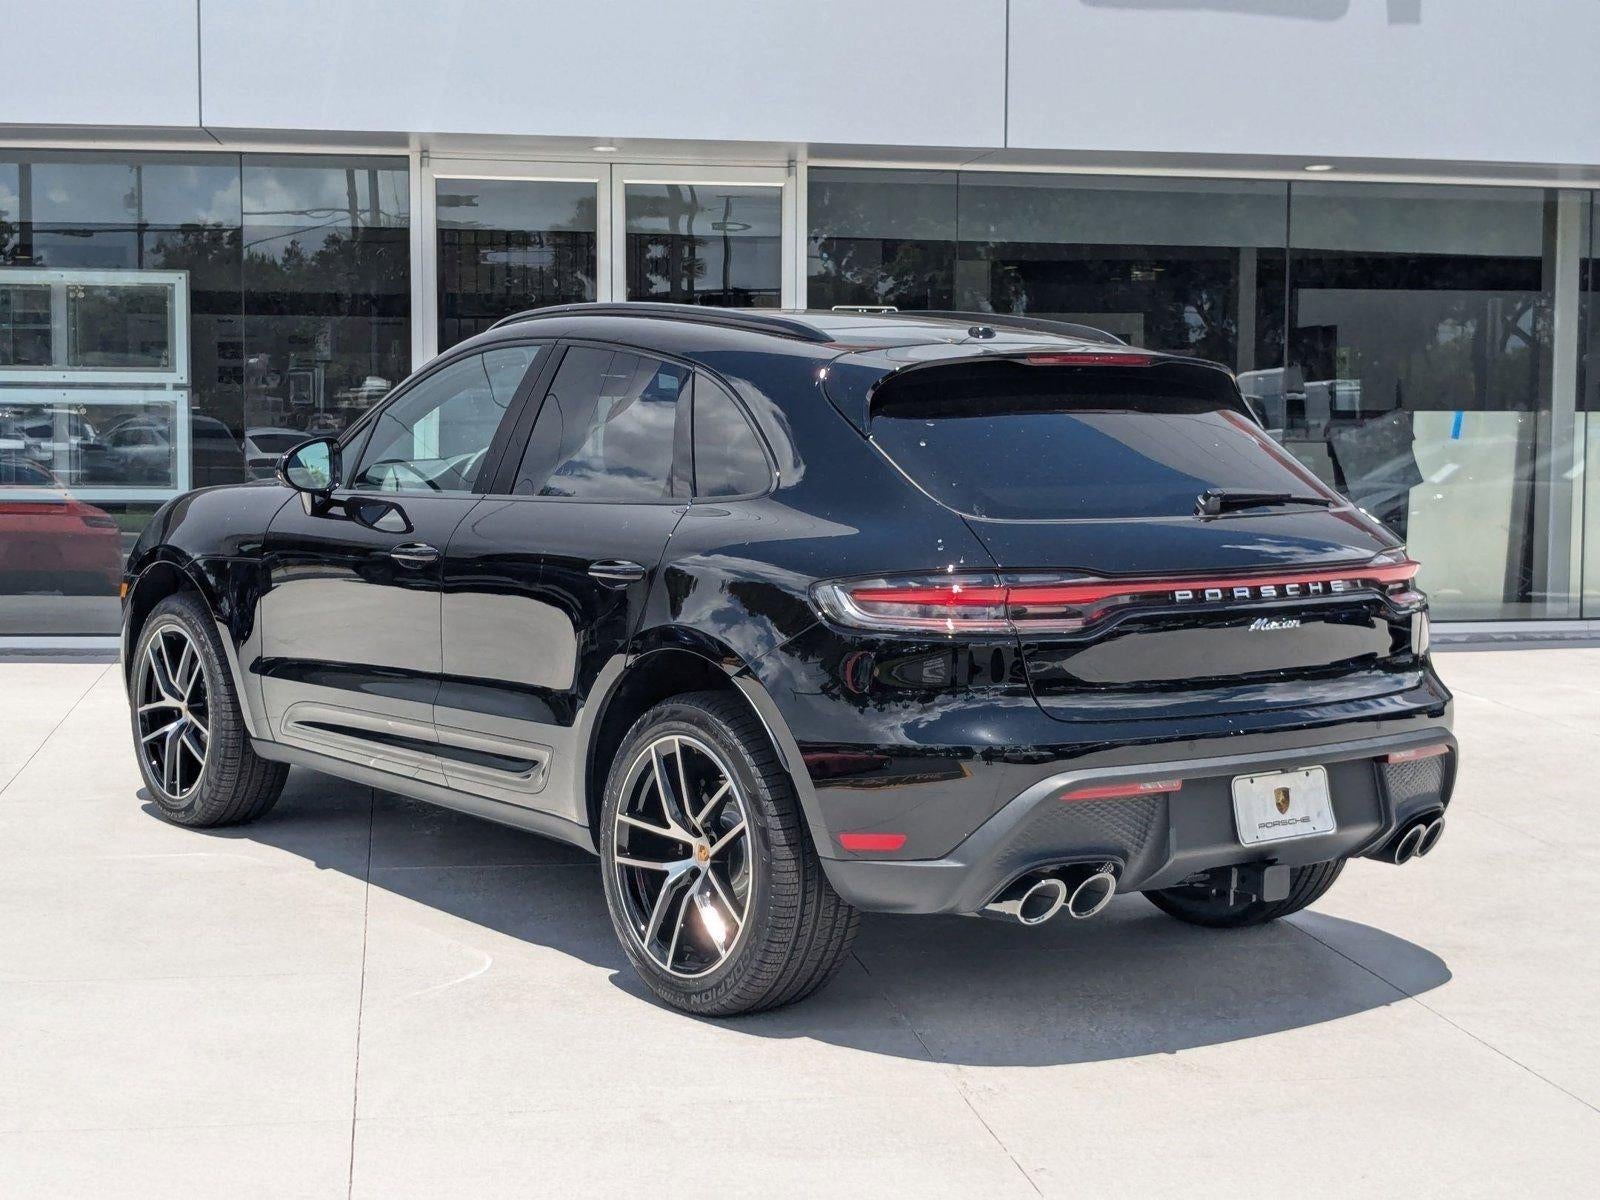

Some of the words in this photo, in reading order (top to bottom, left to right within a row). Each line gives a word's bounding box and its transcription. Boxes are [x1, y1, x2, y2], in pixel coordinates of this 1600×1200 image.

[1174, 579, 1345, 603] PORSCHE
[1248, 617, 1301, 632] Macan
[1257, 816, 1311, 829] PORSCHE
